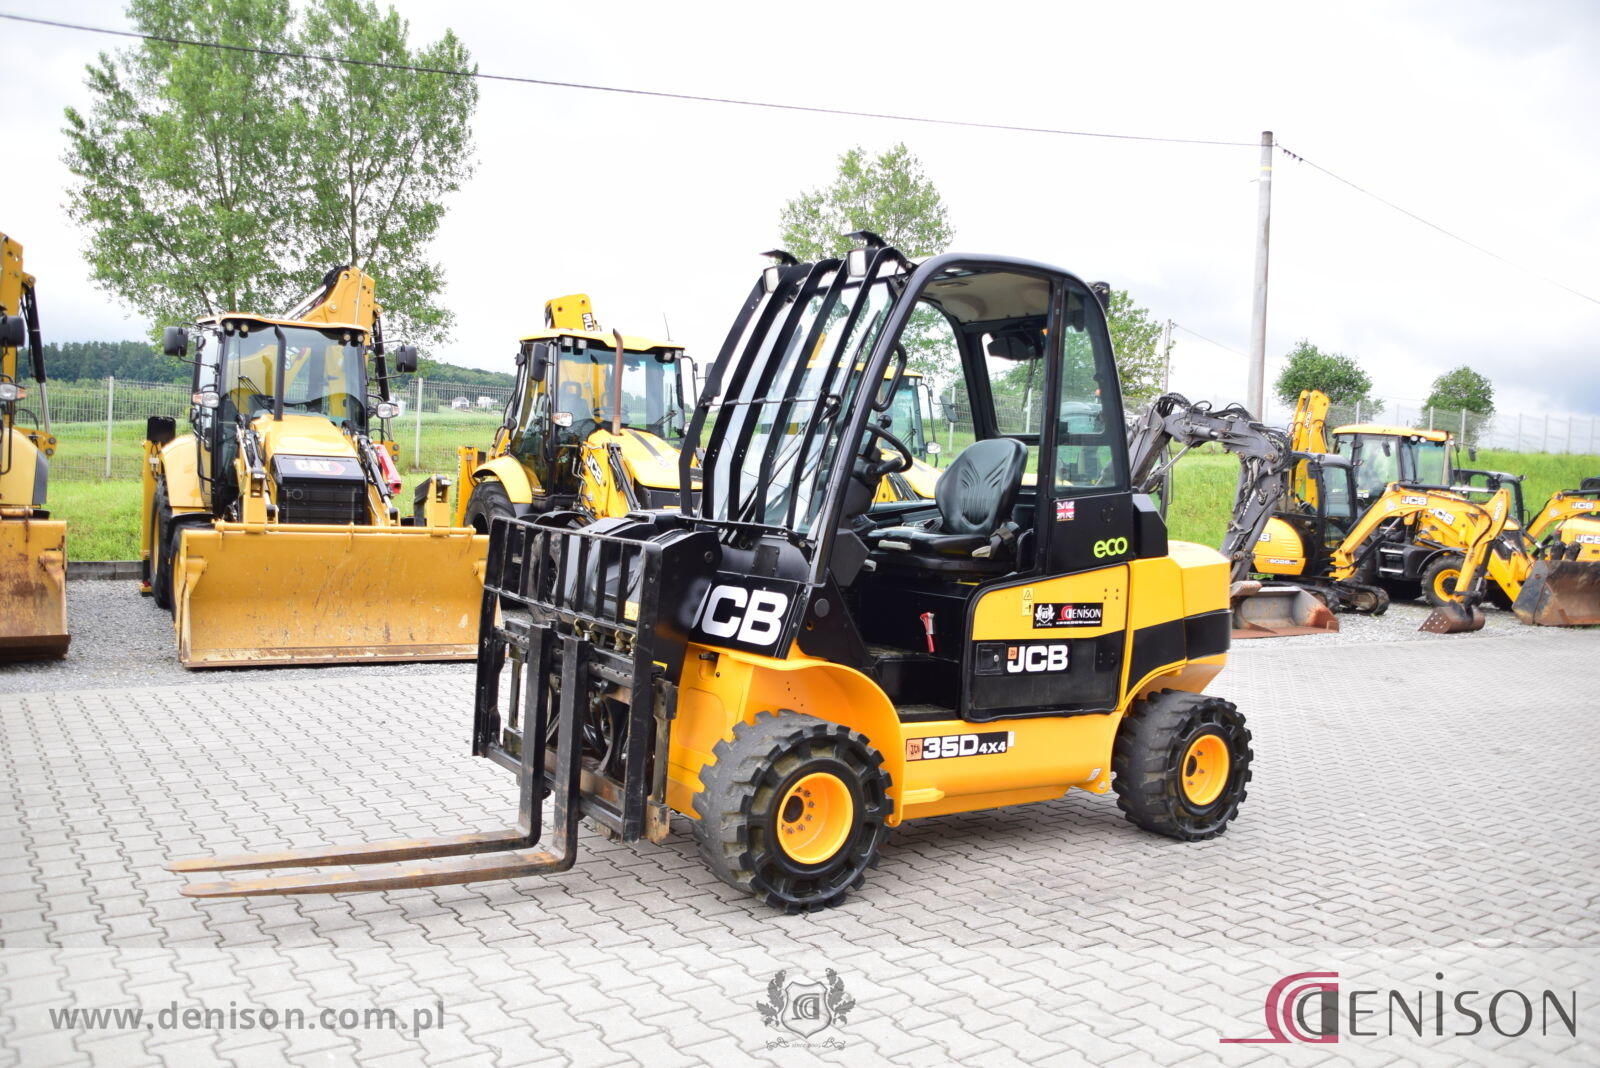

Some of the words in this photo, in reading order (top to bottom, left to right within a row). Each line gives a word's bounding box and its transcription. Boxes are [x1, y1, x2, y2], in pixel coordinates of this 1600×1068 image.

[586, 455, 603, 486] JCB
[1401, 496, 1427, 505] JCB
[1428, 508, 1455, 525] JCB
[1093, 536, 1128, 558] eco
[691, 583, 789, 645] CB
[1006, 644, 1069, 673] JCB
[923, 734, 979, 759] 35D
